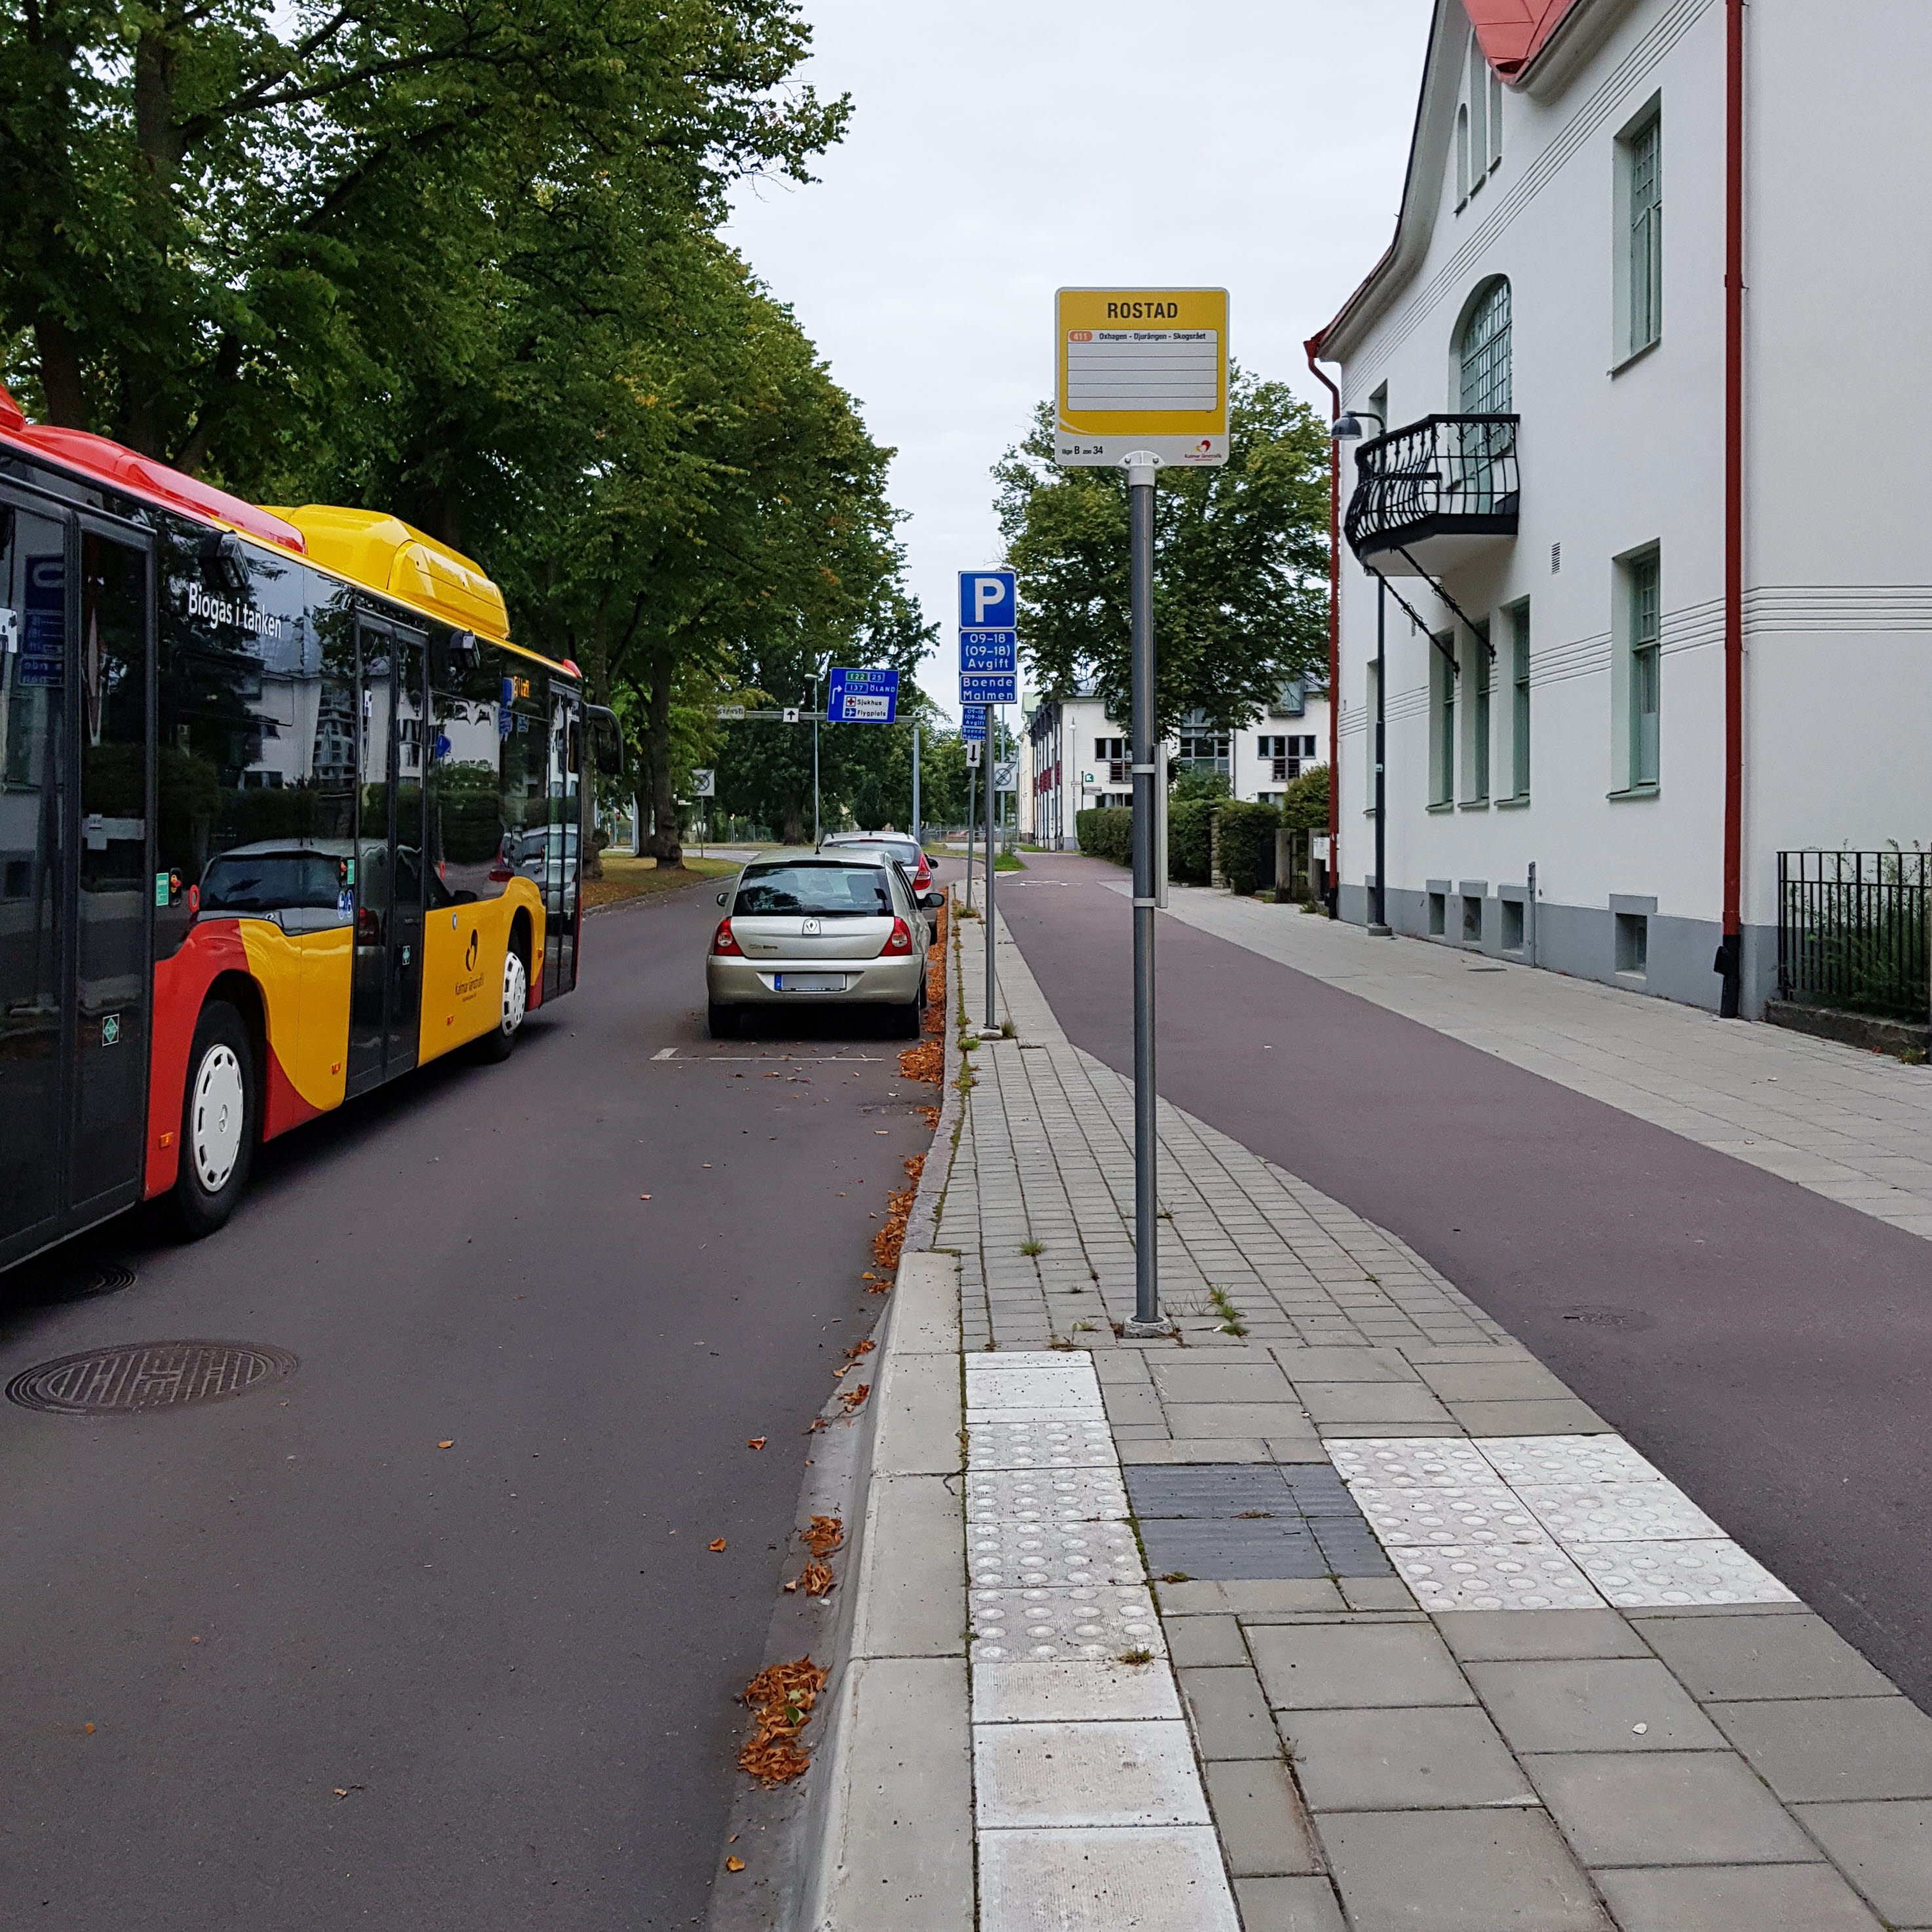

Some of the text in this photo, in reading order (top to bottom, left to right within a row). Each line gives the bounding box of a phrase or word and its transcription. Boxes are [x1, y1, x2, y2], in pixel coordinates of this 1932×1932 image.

[1108, 302, 1178, 319] ROSTAD
[1173, 332, 1206, 341] Skogsrået
[1074, 446, 1080, 454] B
[1093, 446, 1103, 454] 34
[975, 577, 1006, 623] P
[188, 582, 282, 639] Biogas i tanken
[969, 633, 1006, 644] 09-18
[965, 645, 1011, 657] (09-18)
[967, 658, 1009, 670] Avgift
[963, 677, 1013, 687] Boende
[870, 684, 896, 693] ÖLAND
[963, 690, 1013, 701] Malmen
